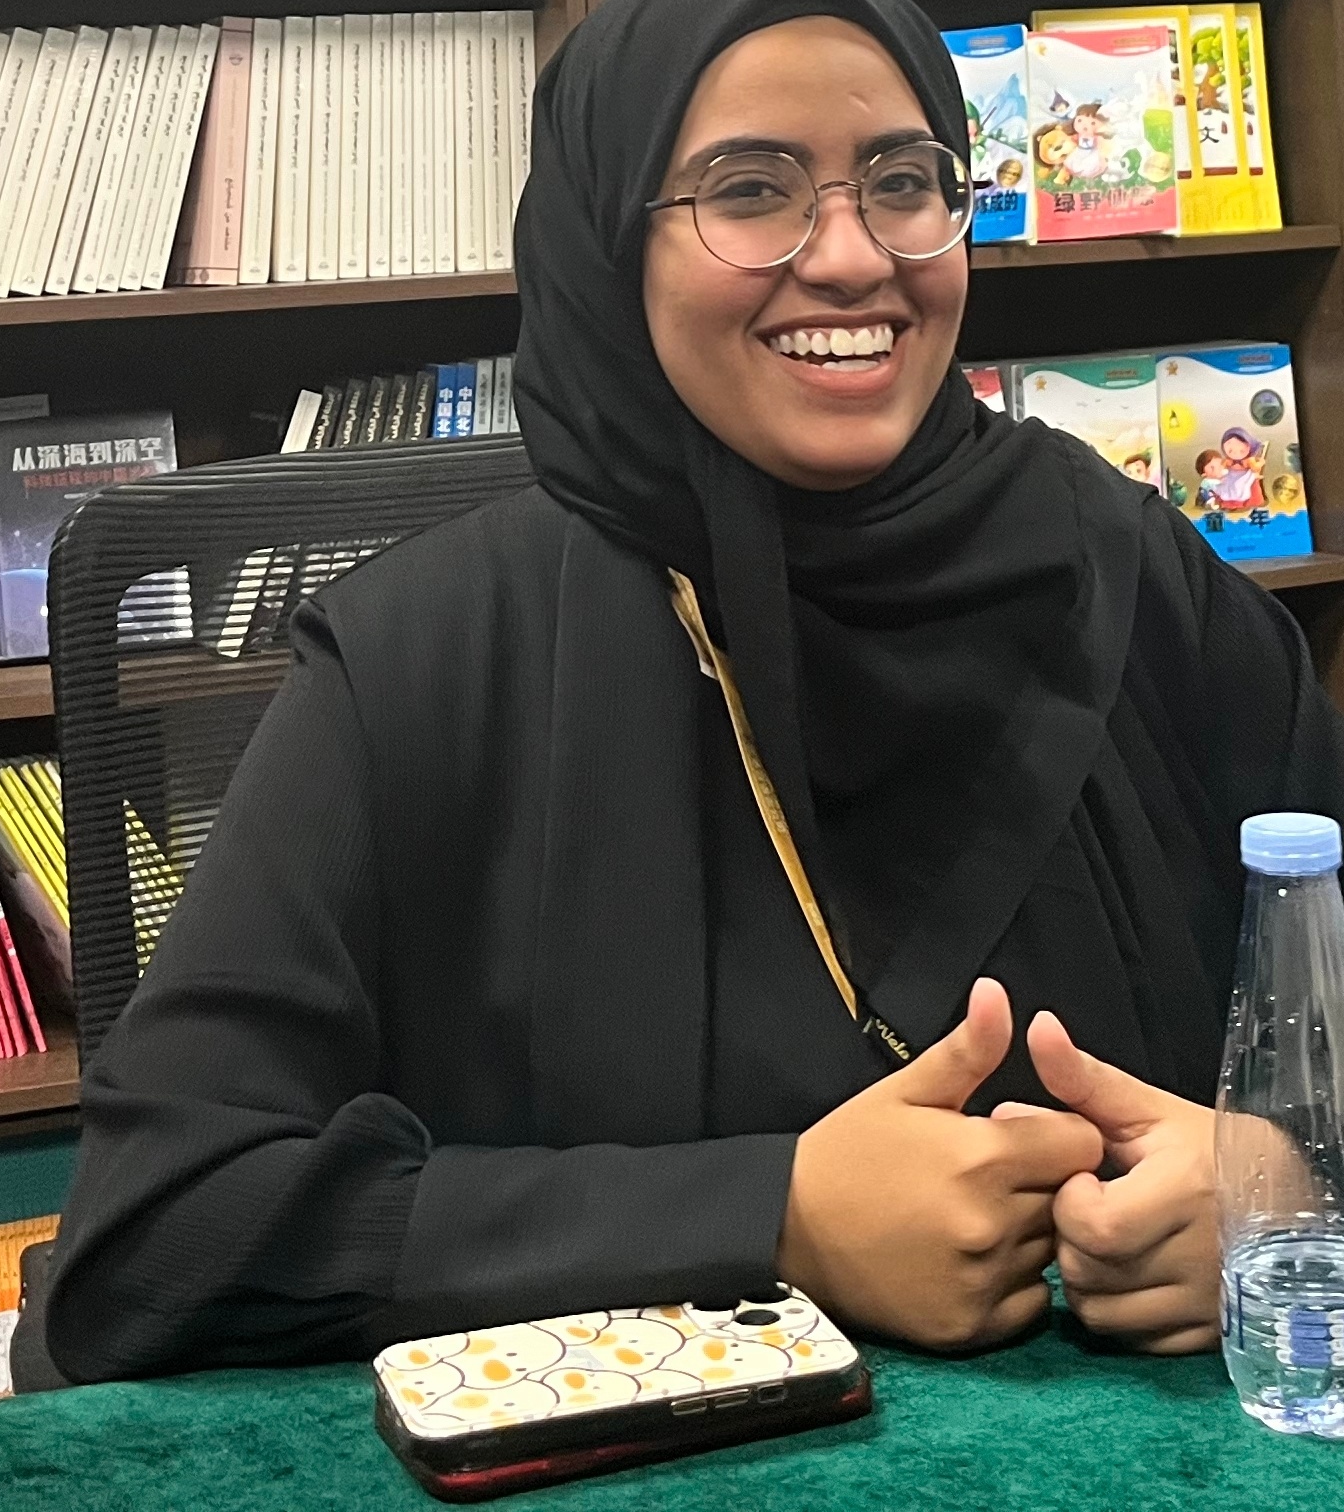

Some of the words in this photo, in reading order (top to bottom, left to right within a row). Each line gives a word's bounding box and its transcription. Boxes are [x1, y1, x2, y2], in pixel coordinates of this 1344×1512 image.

[437, 388, 453, 438] 中国北
[456, 386, 473, 437] 中国北
[11, 437, 165, 473] 从深海到深空
